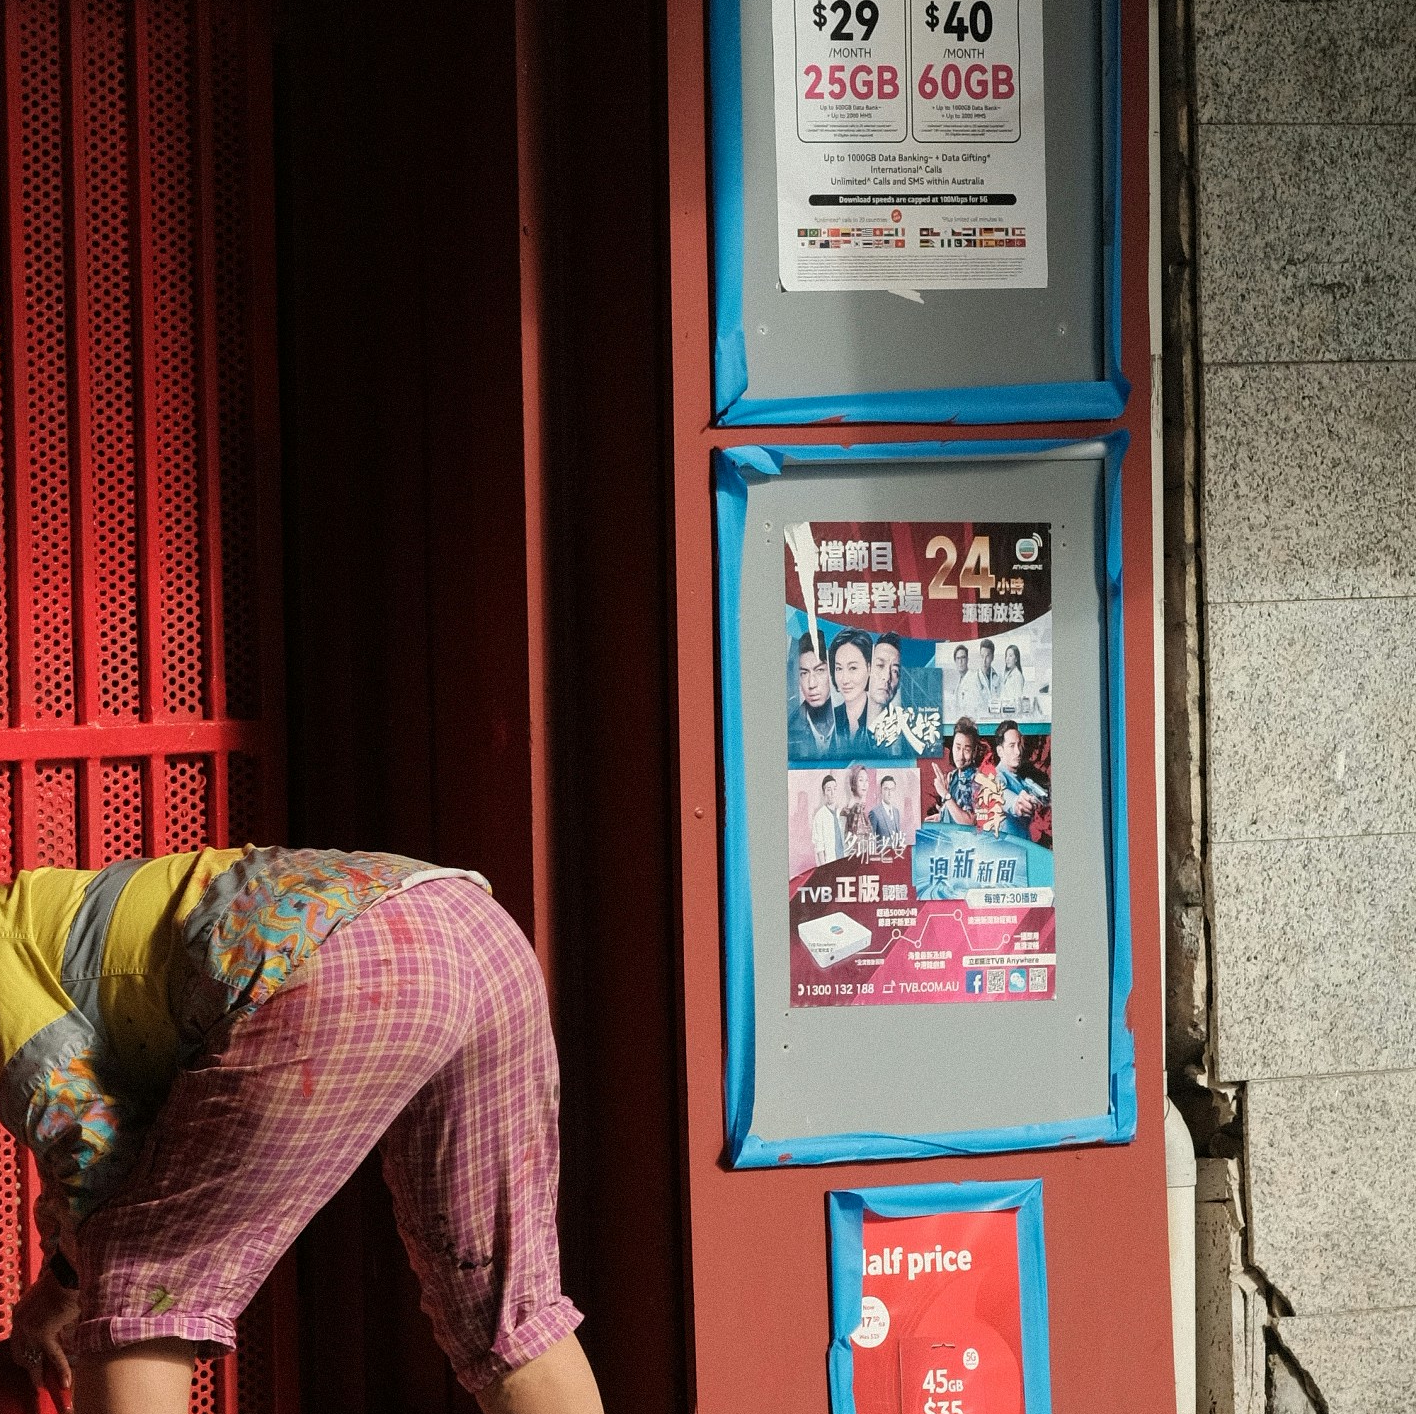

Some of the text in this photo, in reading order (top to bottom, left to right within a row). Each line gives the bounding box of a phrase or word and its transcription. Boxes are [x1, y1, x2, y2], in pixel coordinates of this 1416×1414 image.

[812, 0, 880, 42] $29
[924, 0, 994, 43] $40
[828, 46, 872, 59] /MONTH
[943, 47, 985, 60] /MONTH
[802, 64, 900, 101] 25GB
[917, 64, 1016, 101] 60GB
[823, 153, 835, 164] Up
[836, 154, 846, 163] to
[847, 153, 877, 162] 1000GB
[878, 153, 897, 162] Data
[941, 153, 960, 162] Data
[924, 165, 943, 174] Calls
[873, 176, 891, 186] Calls
[892, 176, 906, 186] and
[907, 177, 925, 186] SMS
[926, 176, 950, 186] within
[951, 176, 985, 186] Australia
[816, 581, 924, 615] 勁爆登場
[929, 846, 1017, 888] 澳新新聞
[806, 983, 875, 996] 1300 132 188
[899, 982, 960, 994] TVB.COM.AU
[907, 1244, 973, 1281] price
[965, 1351, 978, 1363] 5G
[922, 1368, 964, 1394] 45GB
